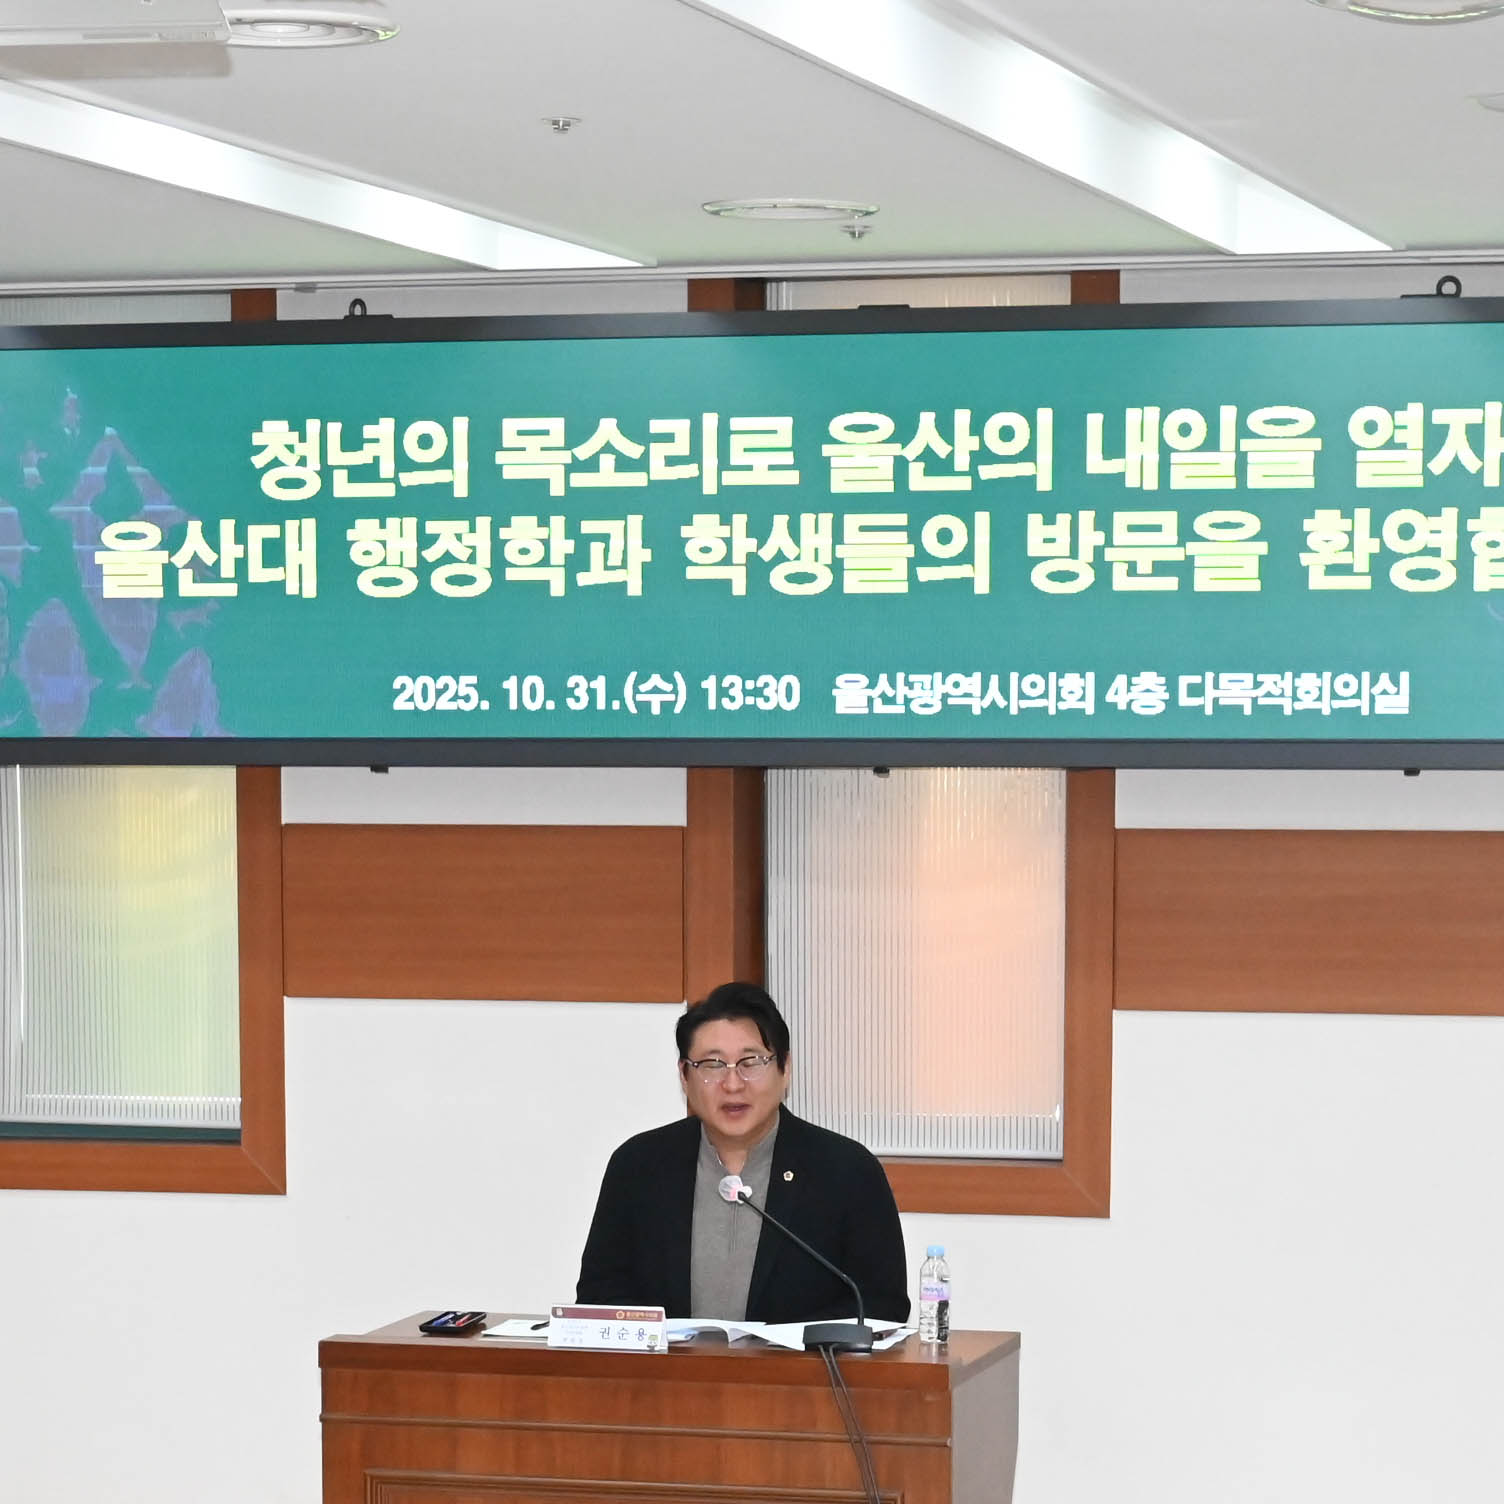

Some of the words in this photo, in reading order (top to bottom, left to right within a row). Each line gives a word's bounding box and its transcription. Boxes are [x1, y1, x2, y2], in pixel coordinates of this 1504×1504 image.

[250, 415, 470, 501] 청년의
[495, 411, 800, 497] 목소리로
[821, 406, 1054, 494] 울산의
[1086, 403, 1323, 491] 내일을
[93, 517, 318, 599] 울산대
[346, 514, 653, 598] 행정학과
[680, 511, 991, 596] 학생들의
[1027, 509, 1269, 594] 방문을
[392, 675, 490, 712] 2025.
[502, 675, 556, 712] 10.
[565, 671, 687, 715] 31.(수)
[700, 674, 801, 711] 13:30
[831, 671, 1096, 716] 울산광역시의회
[1105, 671, 1170, 716] 4층
[1178, 671, 1410, 716] 다목적회의실
